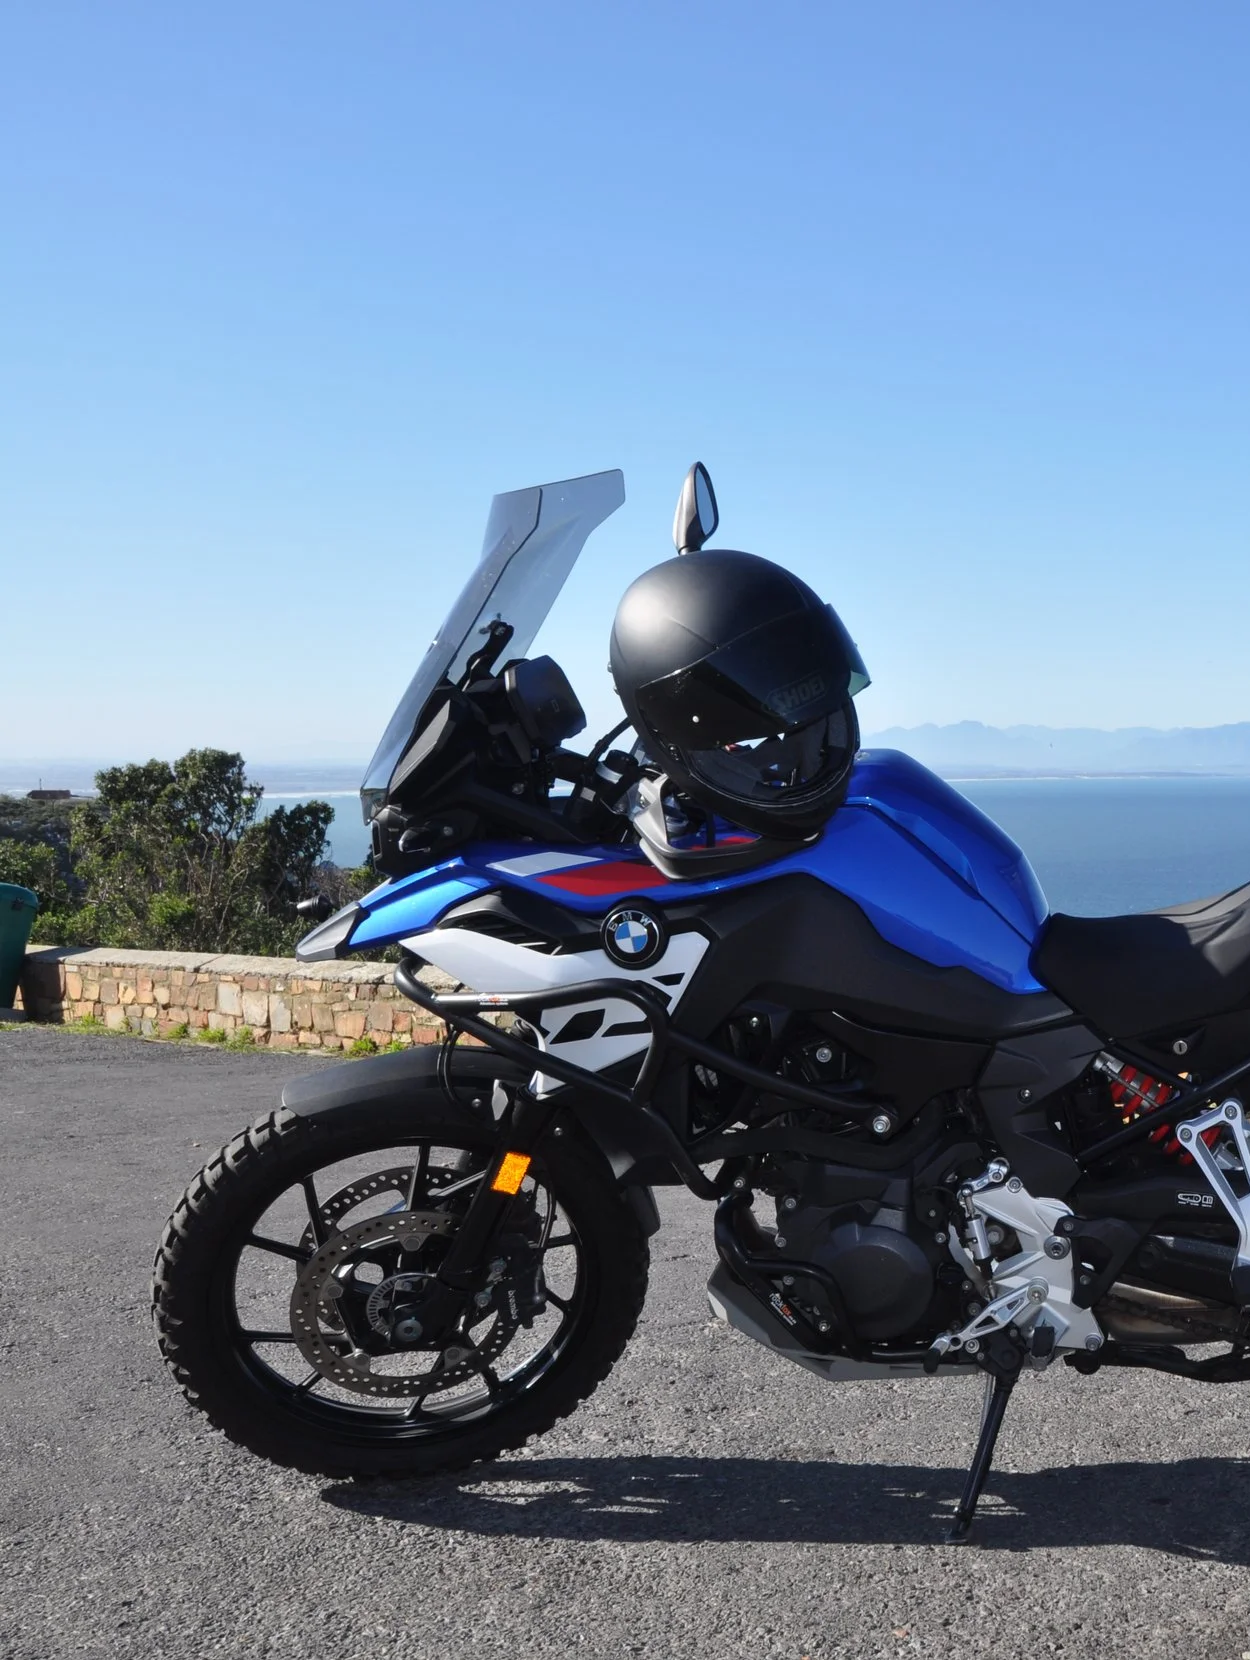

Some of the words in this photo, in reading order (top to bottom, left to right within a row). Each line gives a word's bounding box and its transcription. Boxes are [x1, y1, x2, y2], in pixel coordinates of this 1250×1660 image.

[770, 675, 826, 716] SHOEI
[608, 911, 652, 932] BMW
[507, 1289, 519, 1320] brembo
